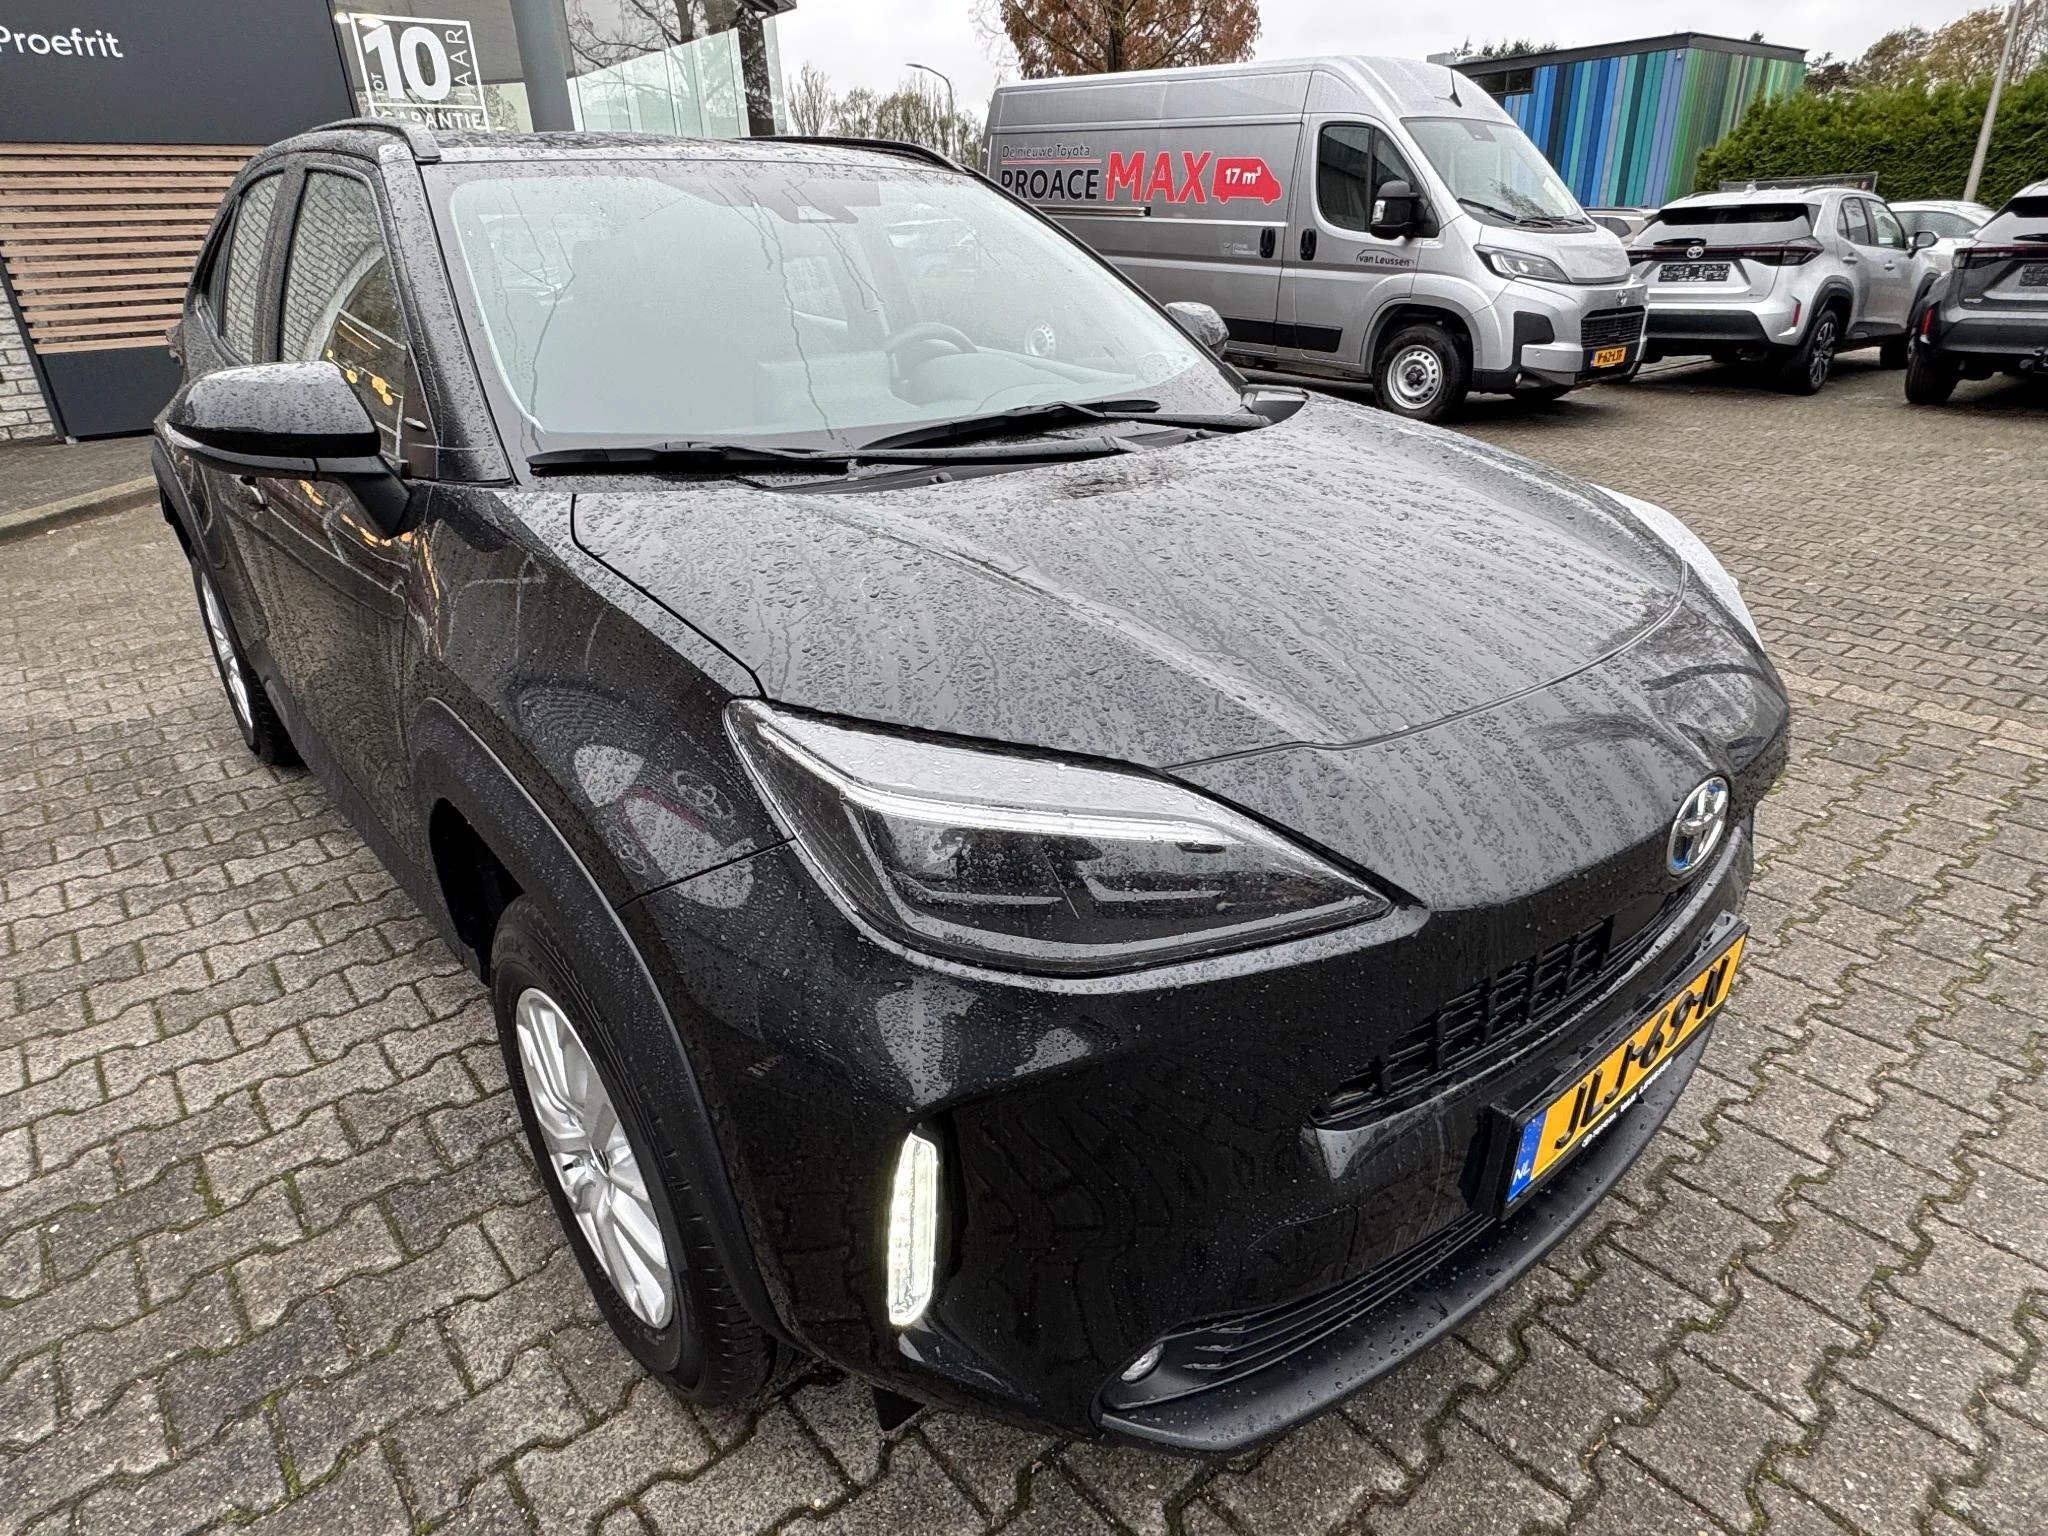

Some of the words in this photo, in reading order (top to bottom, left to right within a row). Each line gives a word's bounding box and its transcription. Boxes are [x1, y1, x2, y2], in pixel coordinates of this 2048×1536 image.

[0, 25, 124, 58] Proefrit
[363, 25, 452, 101] 10
[445, 29, 478, 102] JAAR
[370, 72, 385, 98] TOT
[1002, 145, 1015, 158] De
[1017, 146, 1053, 158] nieuwe
[1056, 144, 1090, 160] Toyota
[1001, 169, 1099, 200] PROACE
[1105, 151, 1213, 204] MAX
[1225, 167, 1239, 185] 17
[1359, 255, 1374, 264] van
[1374, 255, 1410, 267] Leussen
[1512, 1159, 1531, 1186] NL
